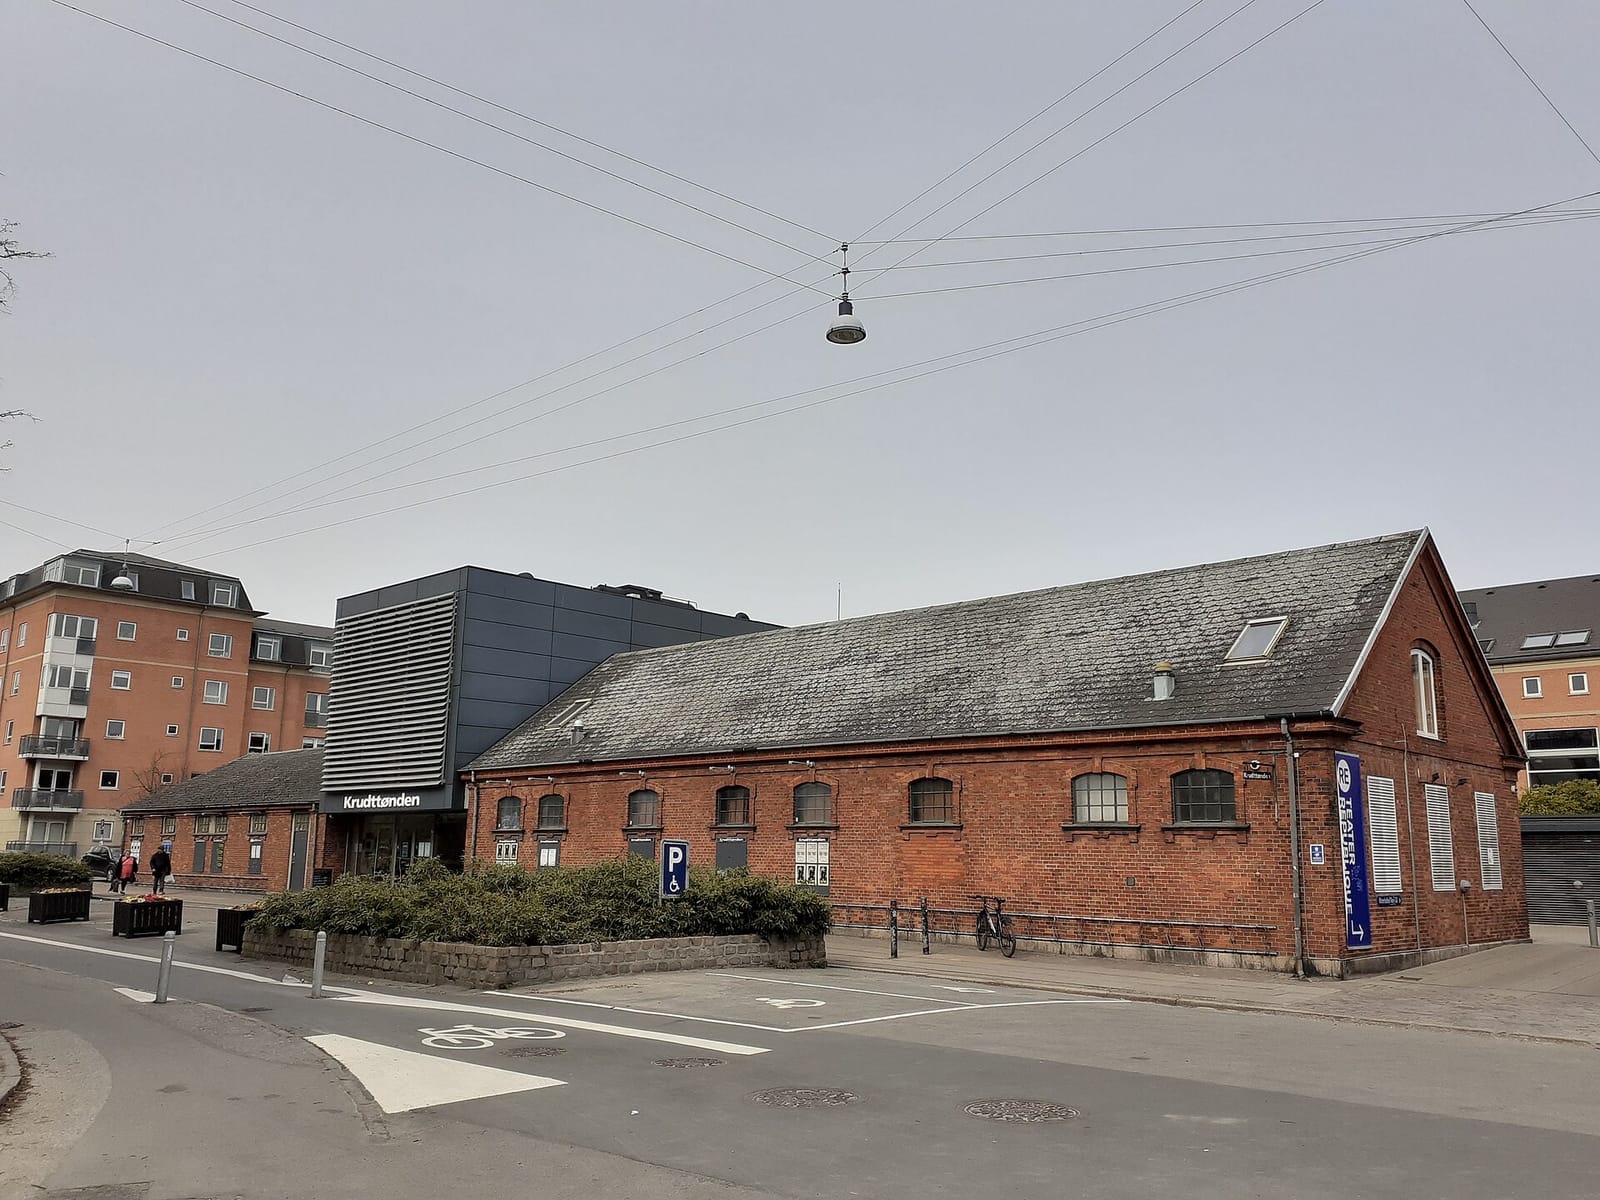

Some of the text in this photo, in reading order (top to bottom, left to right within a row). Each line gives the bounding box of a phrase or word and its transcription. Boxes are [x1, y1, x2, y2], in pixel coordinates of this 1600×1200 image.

[1339, 768, 1349, 784] RE
[344, 792, 420, 809] Krudttønden
[1345, 797, 1356, 866] TEATER
[669, 847, 683, 873] P
